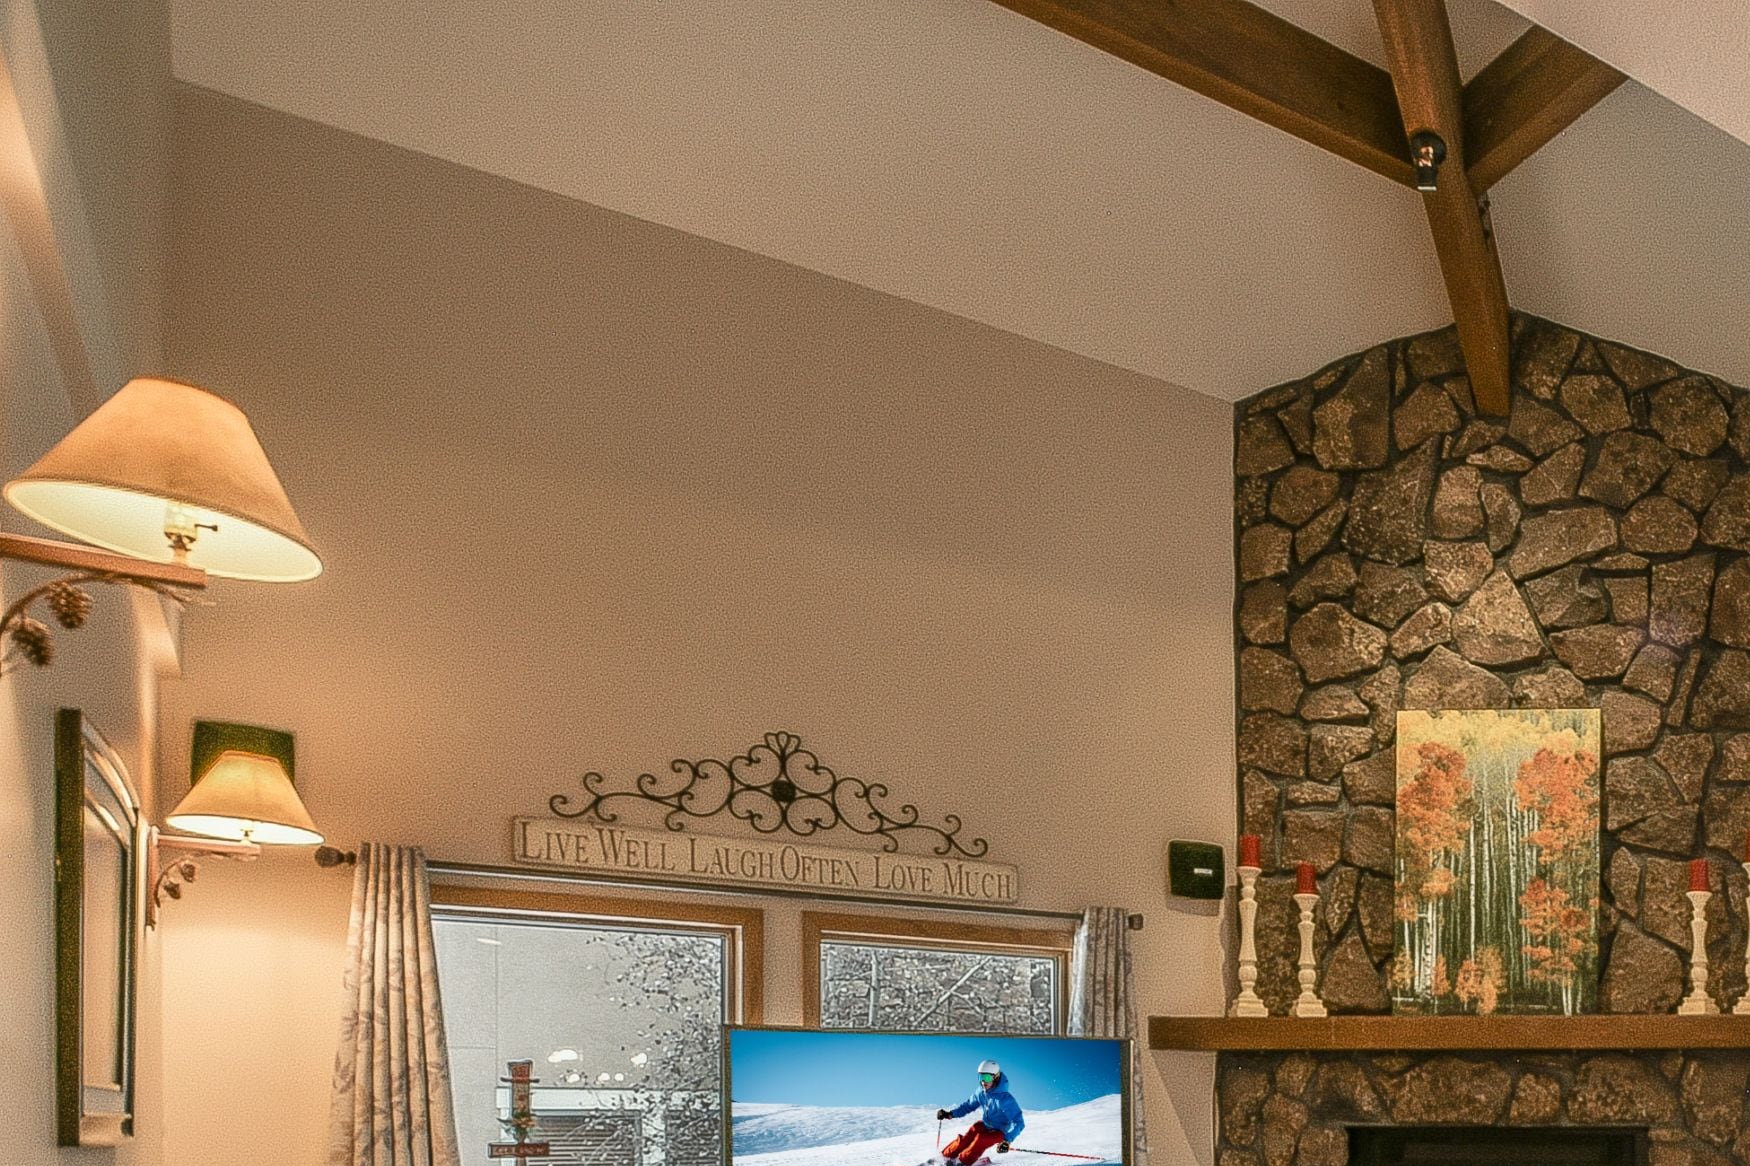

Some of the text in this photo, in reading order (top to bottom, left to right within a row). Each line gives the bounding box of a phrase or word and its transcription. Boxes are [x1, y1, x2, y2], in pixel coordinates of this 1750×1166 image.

[520, 821, 1011, 899] LIVE WELL LAUGH OFTEN LOVE MUCH
